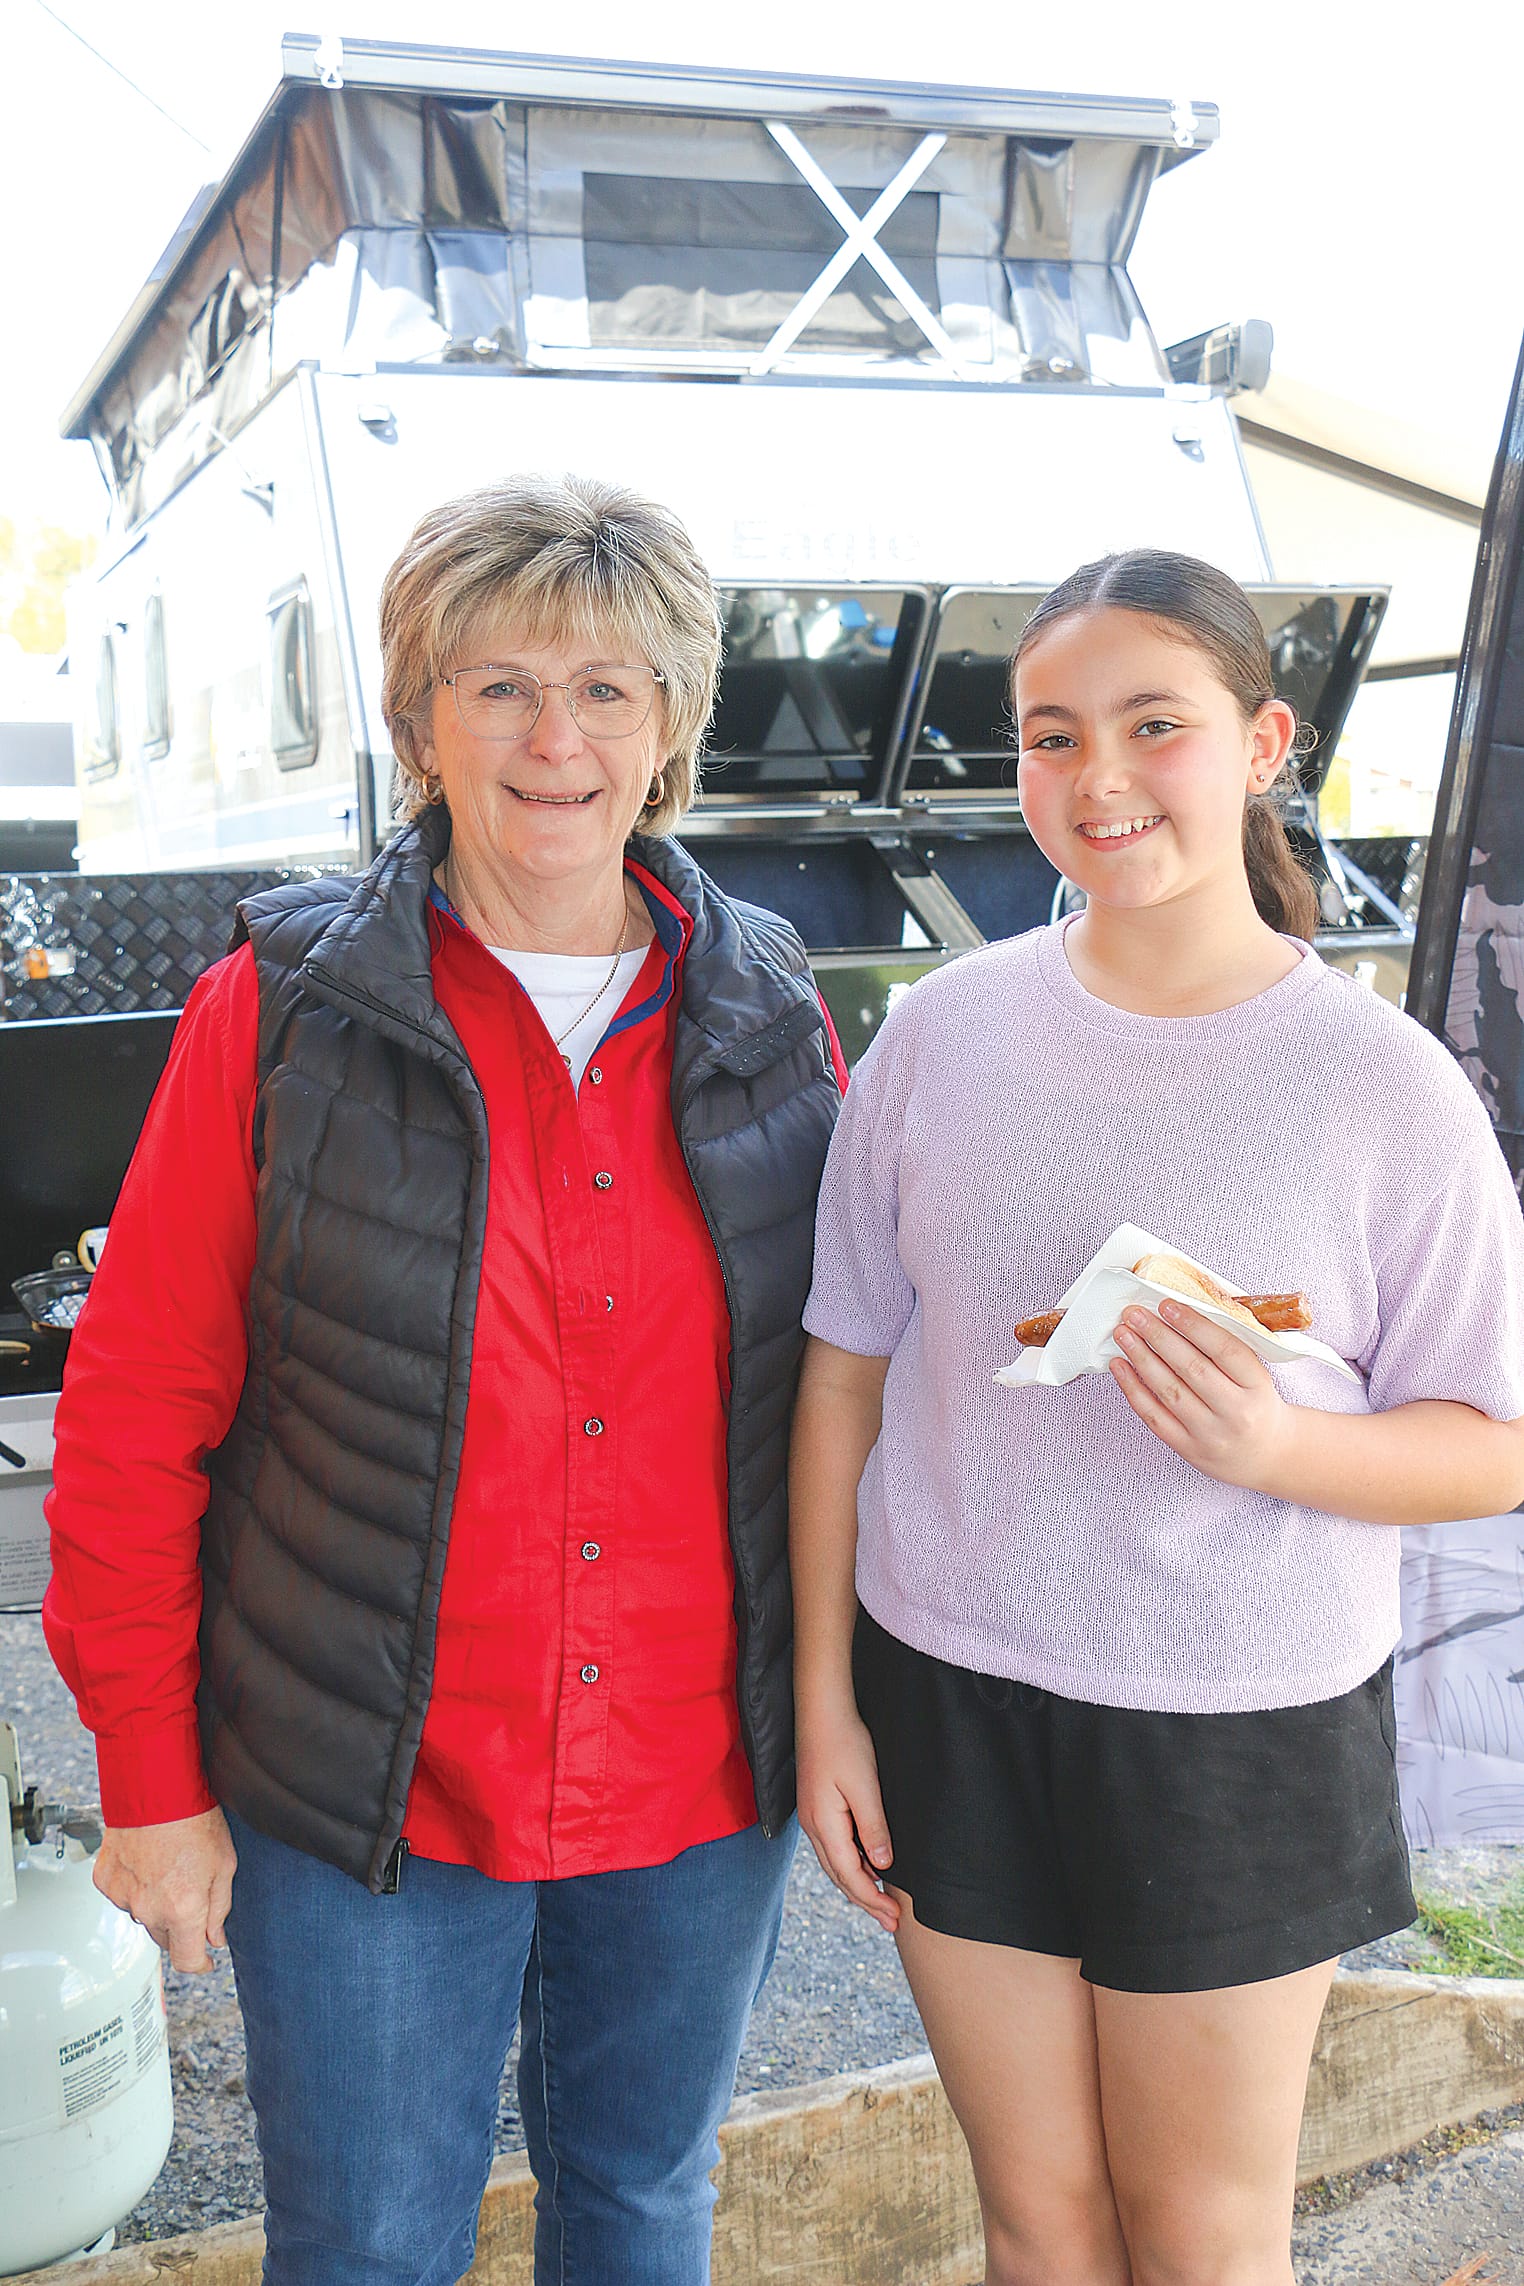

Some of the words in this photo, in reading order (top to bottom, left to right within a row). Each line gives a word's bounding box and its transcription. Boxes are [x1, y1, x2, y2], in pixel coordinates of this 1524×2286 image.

[734, 519, 920, 574] Eagle
[59, 2029, 101, 2056] PETROLEUM
[60, 2042, 96, 2066] LIQUEFIED
